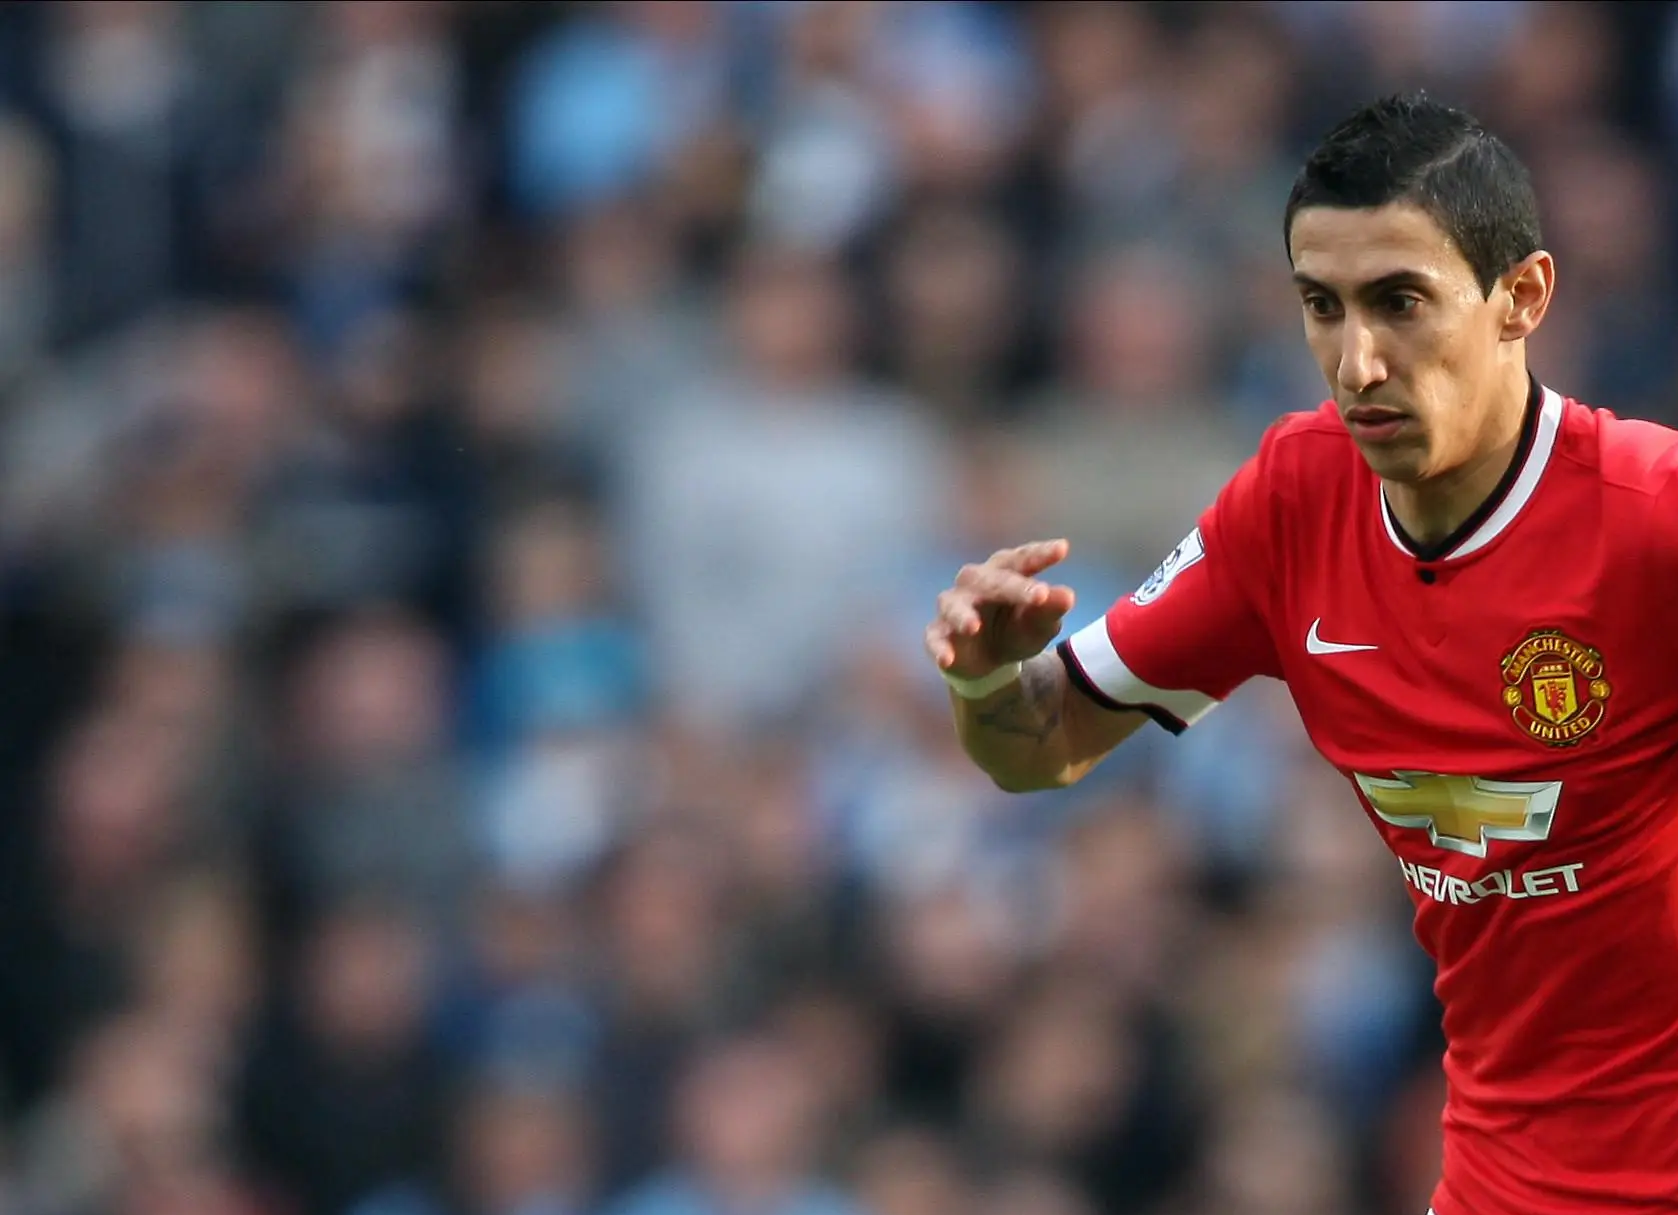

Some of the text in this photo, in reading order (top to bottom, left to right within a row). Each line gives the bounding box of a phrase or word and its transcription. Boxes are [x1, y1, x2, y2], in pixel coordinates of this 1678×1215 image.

[1510, 638, 1595, 675] MANCHESTER
[1530, 717, 1590, 739] UNITED
[1398, 855, 1584, 905] HEVROLET
